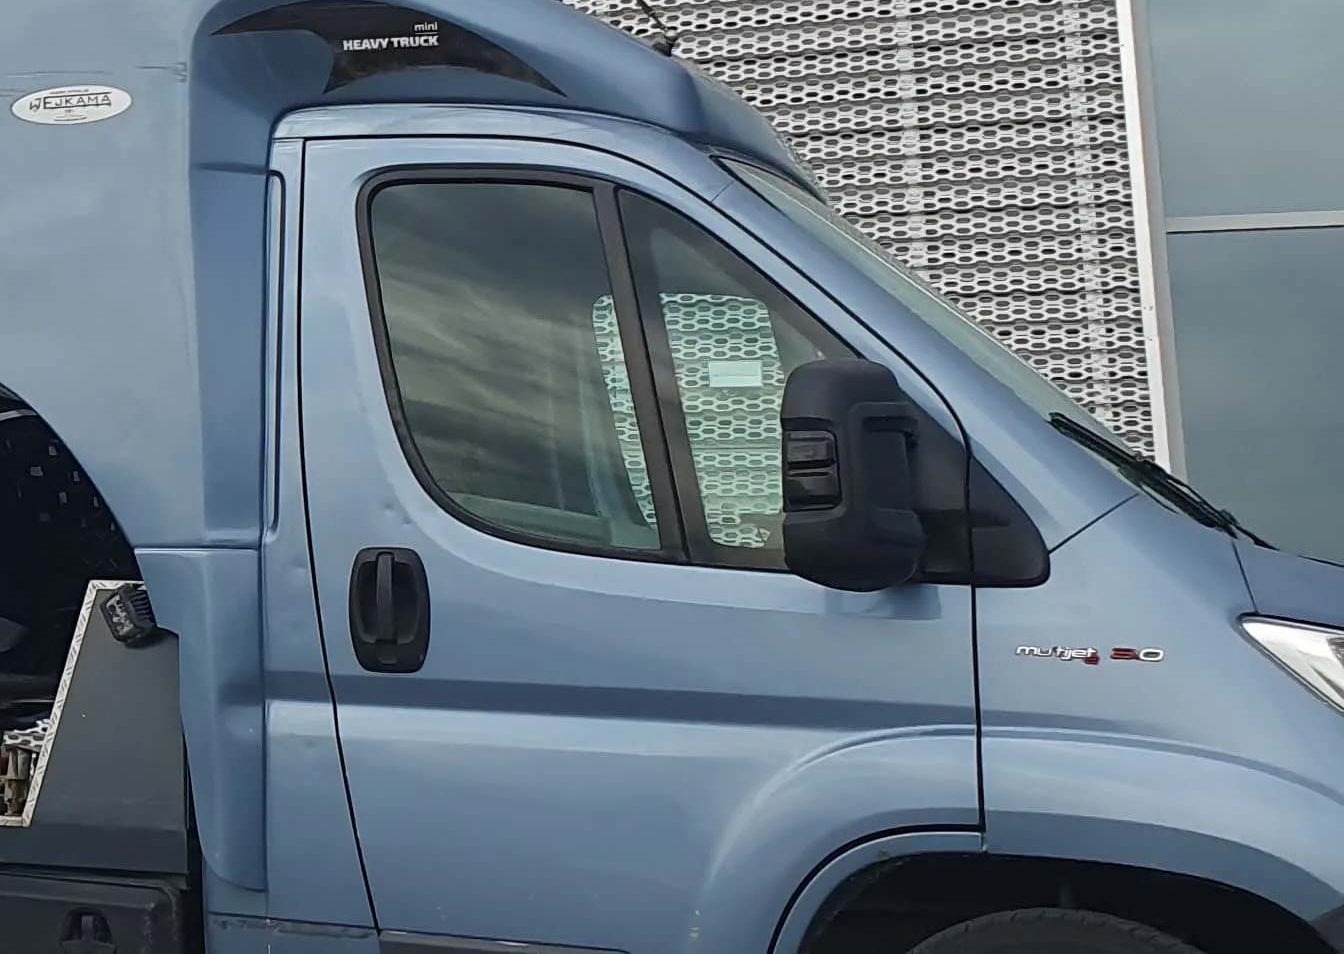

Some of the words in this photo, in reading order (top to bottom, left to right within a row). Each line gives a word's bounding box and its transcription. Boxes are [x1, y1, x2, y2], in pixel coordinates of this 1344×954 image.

[414, 22, 438, 31] mini
[343, 37, 389, 51] HEAVY
[390, 35, 439, 48] TRUCK
[1016, 646, 1097, 661] mutijet
